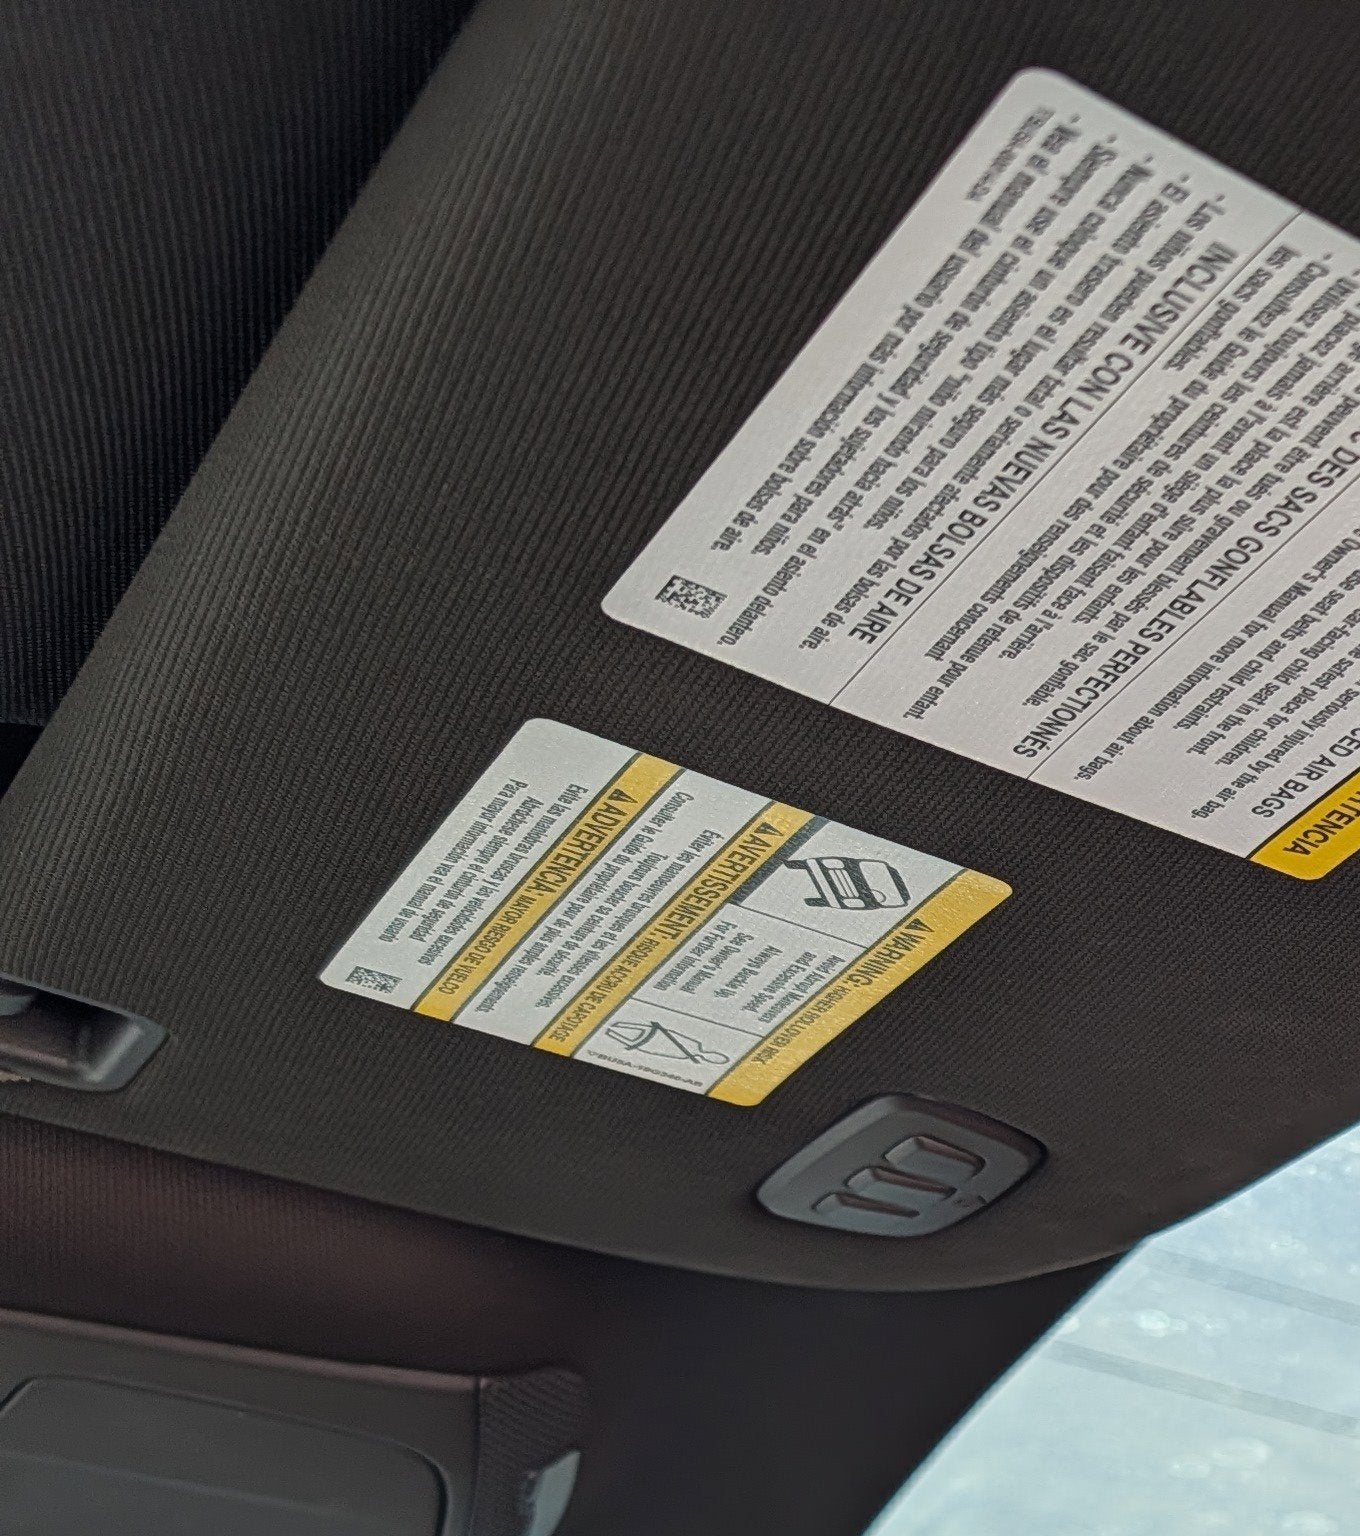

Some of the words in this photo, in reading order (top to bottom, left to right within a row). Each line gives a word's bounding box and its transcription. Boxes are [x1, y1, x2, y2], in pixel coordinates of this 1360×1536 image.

[1117, 241, 1236, 355] INCLUSIVE
[1075, 351, 1133, 401] CON
[1039, 395, 1093, 439] LAS
[971, 435, 1055, 512] NUEVAS
[1305, 445, 1360, 488] DES
[1251, 485, 1318, 537] SACS
[906, 508, 988, 581] BOLSAS
[882, 576, 923, 606] DE
[1136, 535, 1263, 642] GONFLABLES
[1255, 580, 1313, 624] Manual
[1308, 588, 1345, 616] seat
[846, 599, 898, 644] AIRE
[1238, 619, 1268, 638] for
[1278, 612, 1321, 641] belts
[1208, 635, 1246, 663] more
[1255, 638, 1287, 663] and
[1226, 658, 1264, 687] child
[1272, 657, 1309, 686] child
[1308, 656, 1354, 690] safest
[1011, 639, 1151, 758] PERFECTIONNÉS
[1145, 661, 1221, 717] information
[1246, 681, 1280, 706] seat
[1278, 684, 1318, 715] place
[1171, 682, 1235, 730] restraints.
[1233, 702, 1259, 716] in
[1299, 687, 1360, 731] seriously
[1115, 714, 1154, 745] about
[1214, 713, 1246, 732] the
[1261, 712, 1289, 730] for
[1101, 741, 1124, 758] air
[1184, 729, 1226, 755] front.
[1213, 727, 1268, 765] children.
[1262, 728, 1313, 764] injured
[1072, 755, 1113, 780] bags.
[1229, 771, 1259, 789] the
[1245, 759, 1274, 774] by
[1294, 753, 1336, 781] AIR
[496, 777, 528, 799] Para
[556, 782, 589, 805] Evite
[1214, 786, 1237, 802] air
[1250, 778, 1309, 818] BAGS
[477, 796, 509, 823] mayor
[496, 795, 544, 836] Abróchese
[545, 802, 571, 817] las
[647, 790, 694, 828] Consulter
[1189, 799, 1225, 819] bag.
[442, 819, 493, 864] información
[512, 814, 557, 854] maniobras
[638, 824, 663, 835] le
[686, 828, 724, 853] Éviter
[472, 834, 509, 865] siempre
[523, 801, 628, 897] ADVERTENCIA:
[620, 832, 654, 856] Guide
[674, 849, 701, 864] les
[431, 862, 455, 877] vea
[465, 862, 485, 874] el
[488, 851, 528, 882] bruscas
[610, 853, 633, 866] du
[626, 851, 669, 882] Toujours
[424, 875, 444, 886] el
[441, 870, 479, 900] cinturón
[474, 884, 500, 898] las
[481, 877, 501, 888] y
[574, 861, 622, 904] propriétaire
[602, 879, 641, 908] boucler
[648, 832, 772, 940] AVERTISSEMENT:
[404, 882, 437, 911] manual
[434, 898, 456, 910] de
[497, 893, 537, 925] MAYOR
[560, 900, 585, 920] pour
[593, 904, 613, 916] sa
[396, 907, 419, 919] de
[407, 907, 446, 943] seguridad
[442, 896, 486, 936] velocidades
[550, 917, 573, 929] de
[607, 900, 651, 933] brusques
[712, 919, 738, 934] For
[376, 916, 409, 943] usuario
[472, 921, 512, 954] RIESGO
[538, 925, 563, 943] plus
[568, 913, 604, 942] ceinture
[599, 930, 618, 942] et
[727, 931, 754, 946] See
[416, 933, 454, 966] excesivas
[516, 940, 549, 966] amples
[559, 939, 581, 951] de
[589, 937, 614, 951] les
[619, 936, 660, 968] RISQUE
[688, 930, 725, 957] Further
[701, 944, 741, 971] Owner's
[744, 944, 783, 969] Always
[462, 951, 486, 966] DE
[565, 948, 601, 976] vitesses
[651, 954, 702, 991] Information
[793, 950, 817, 967] and
[840, 930, 926, 988] WARNING:
[436, 963, 477, 995] VUELCO
[594, 964, 632, 993] ACCRU
[678, 968, 715, 995] Manual
[723, 966, 760, 990] Buckle
[761, 963, 807, 994] Excessive
[583, 990, 608, 1004] DE
[712, 987, 737, 998] Up.
[738, 991, 774, 1013] Speed.
[808, 984, 852, 1013] HIGHER
[546, 1001, 596, 1043] CAPOTAGE
[768, 1010, 821, 1048] ROLLOVER
